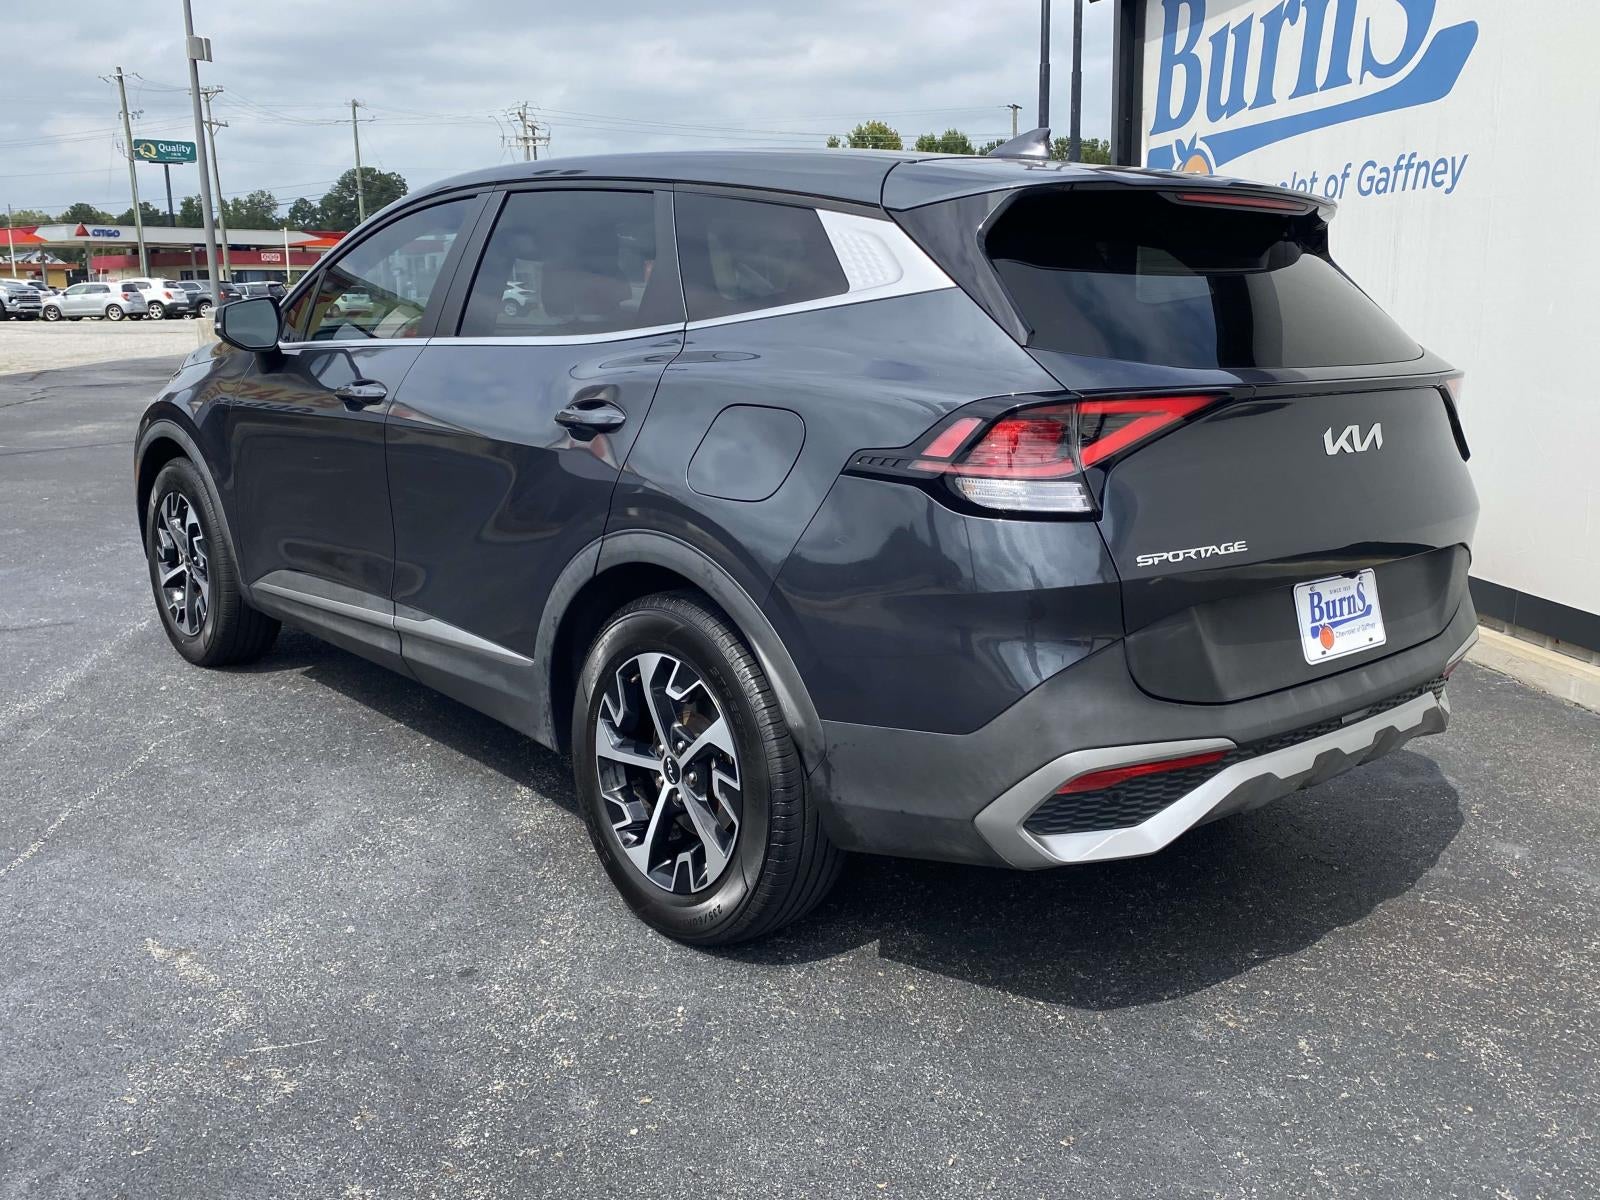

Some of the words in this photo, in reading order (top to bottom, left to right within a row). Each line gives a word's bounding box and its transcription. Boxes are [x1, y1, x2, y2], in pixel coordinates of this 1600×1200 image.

[158, 143, 191, 154] Quality
[1324, 162, 1352, 199] of
[1357, 152, 1468, 196] Gaffney
[1323, 422, 1383, 456] KIA
[1136, 540, 1248, 567] SPORTAGE
